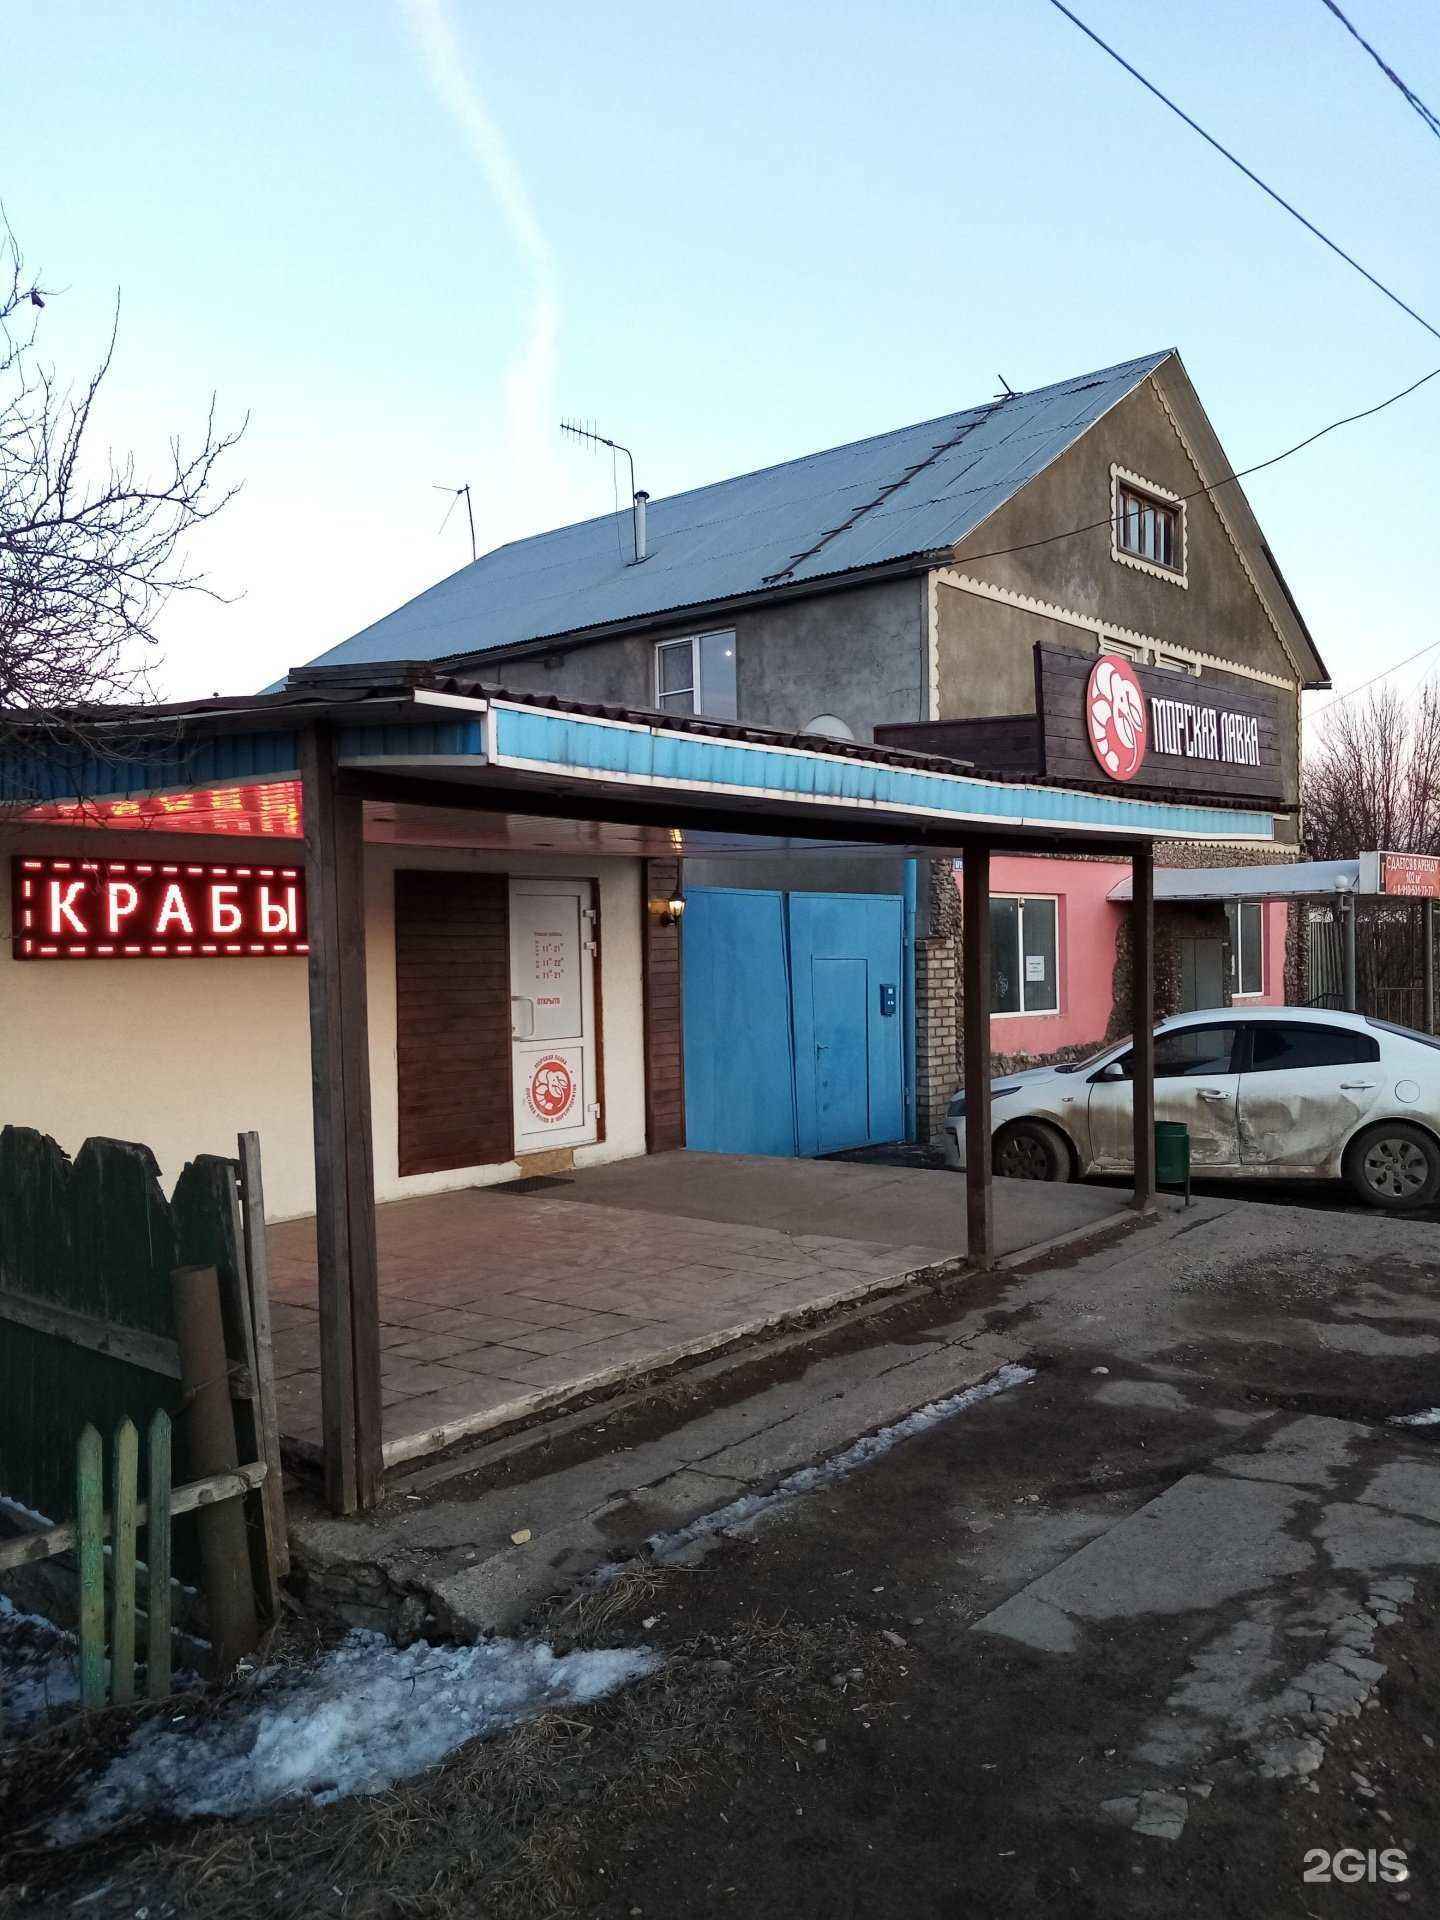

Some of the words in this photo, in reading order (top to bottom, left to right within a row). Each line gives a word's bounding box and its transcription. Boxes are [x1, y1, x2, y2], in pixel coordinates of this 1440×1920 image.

[1151, 697, 1219, 761] МОРСКАЯ
[1220, 711, 1261, 767] ЛАВКА
[50, 881, 297, 933] КРАБЫ
